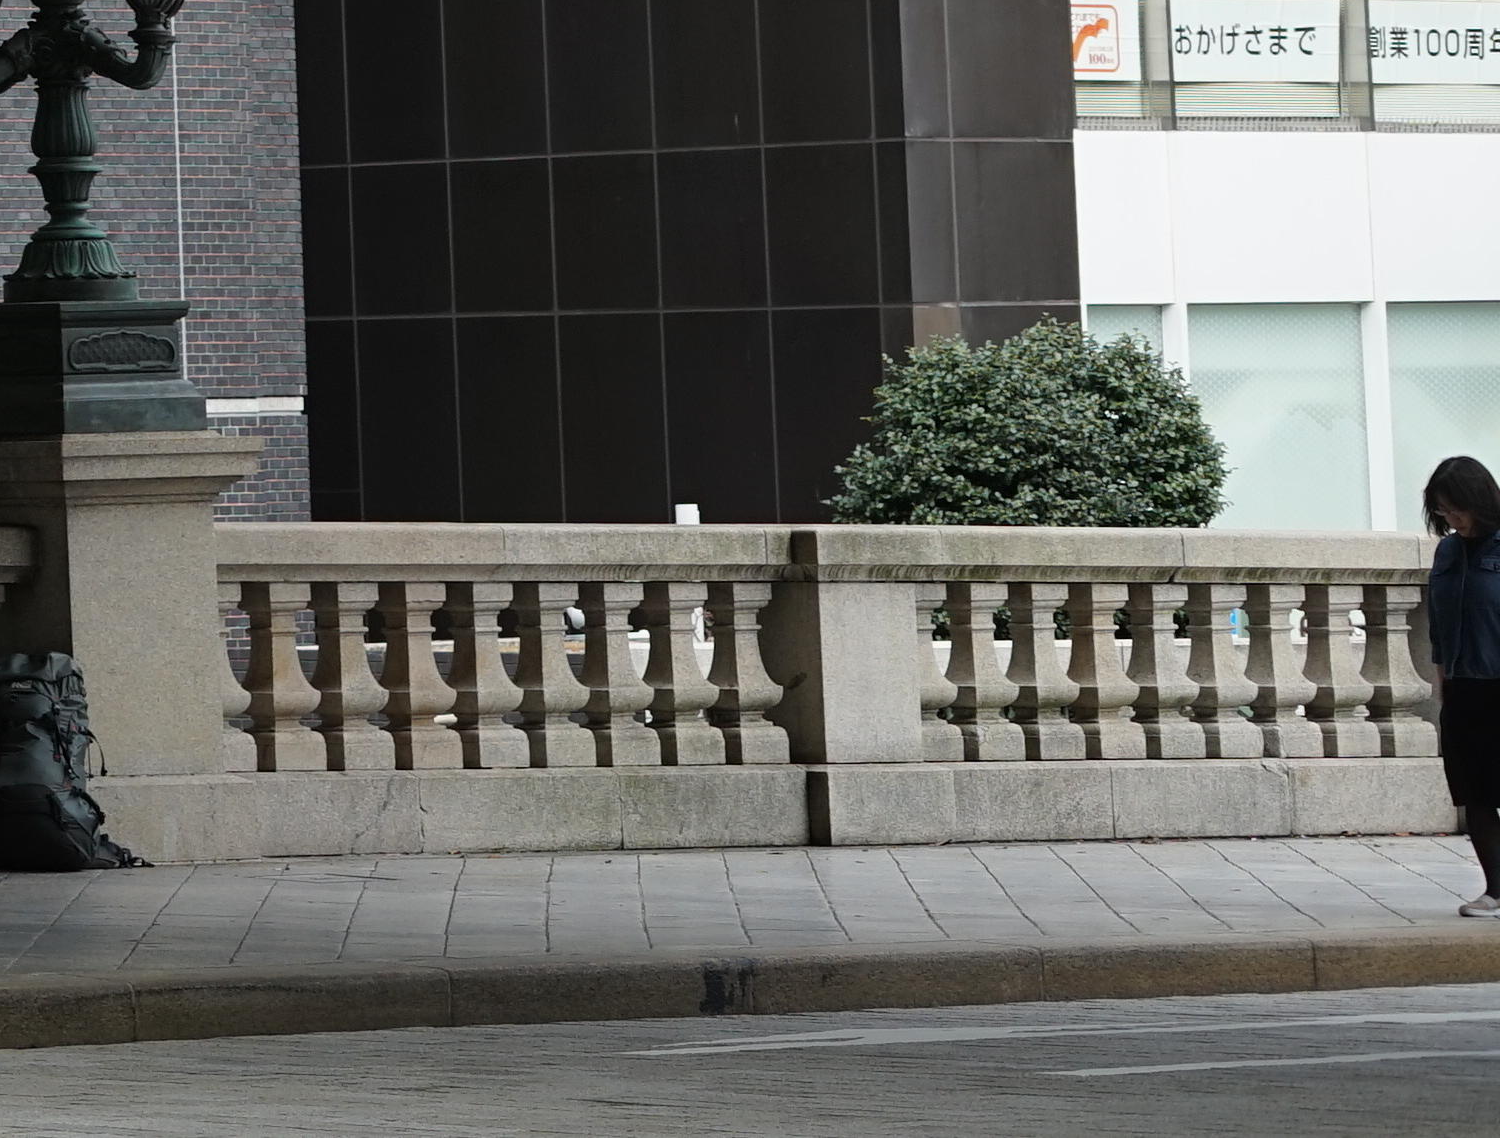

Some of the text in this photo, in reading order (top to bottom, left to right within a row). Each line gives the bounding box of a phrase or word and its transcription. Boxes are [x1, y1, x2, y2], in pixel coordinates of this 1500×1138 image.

[1175, 24, 1316, 55] おかげさまで
